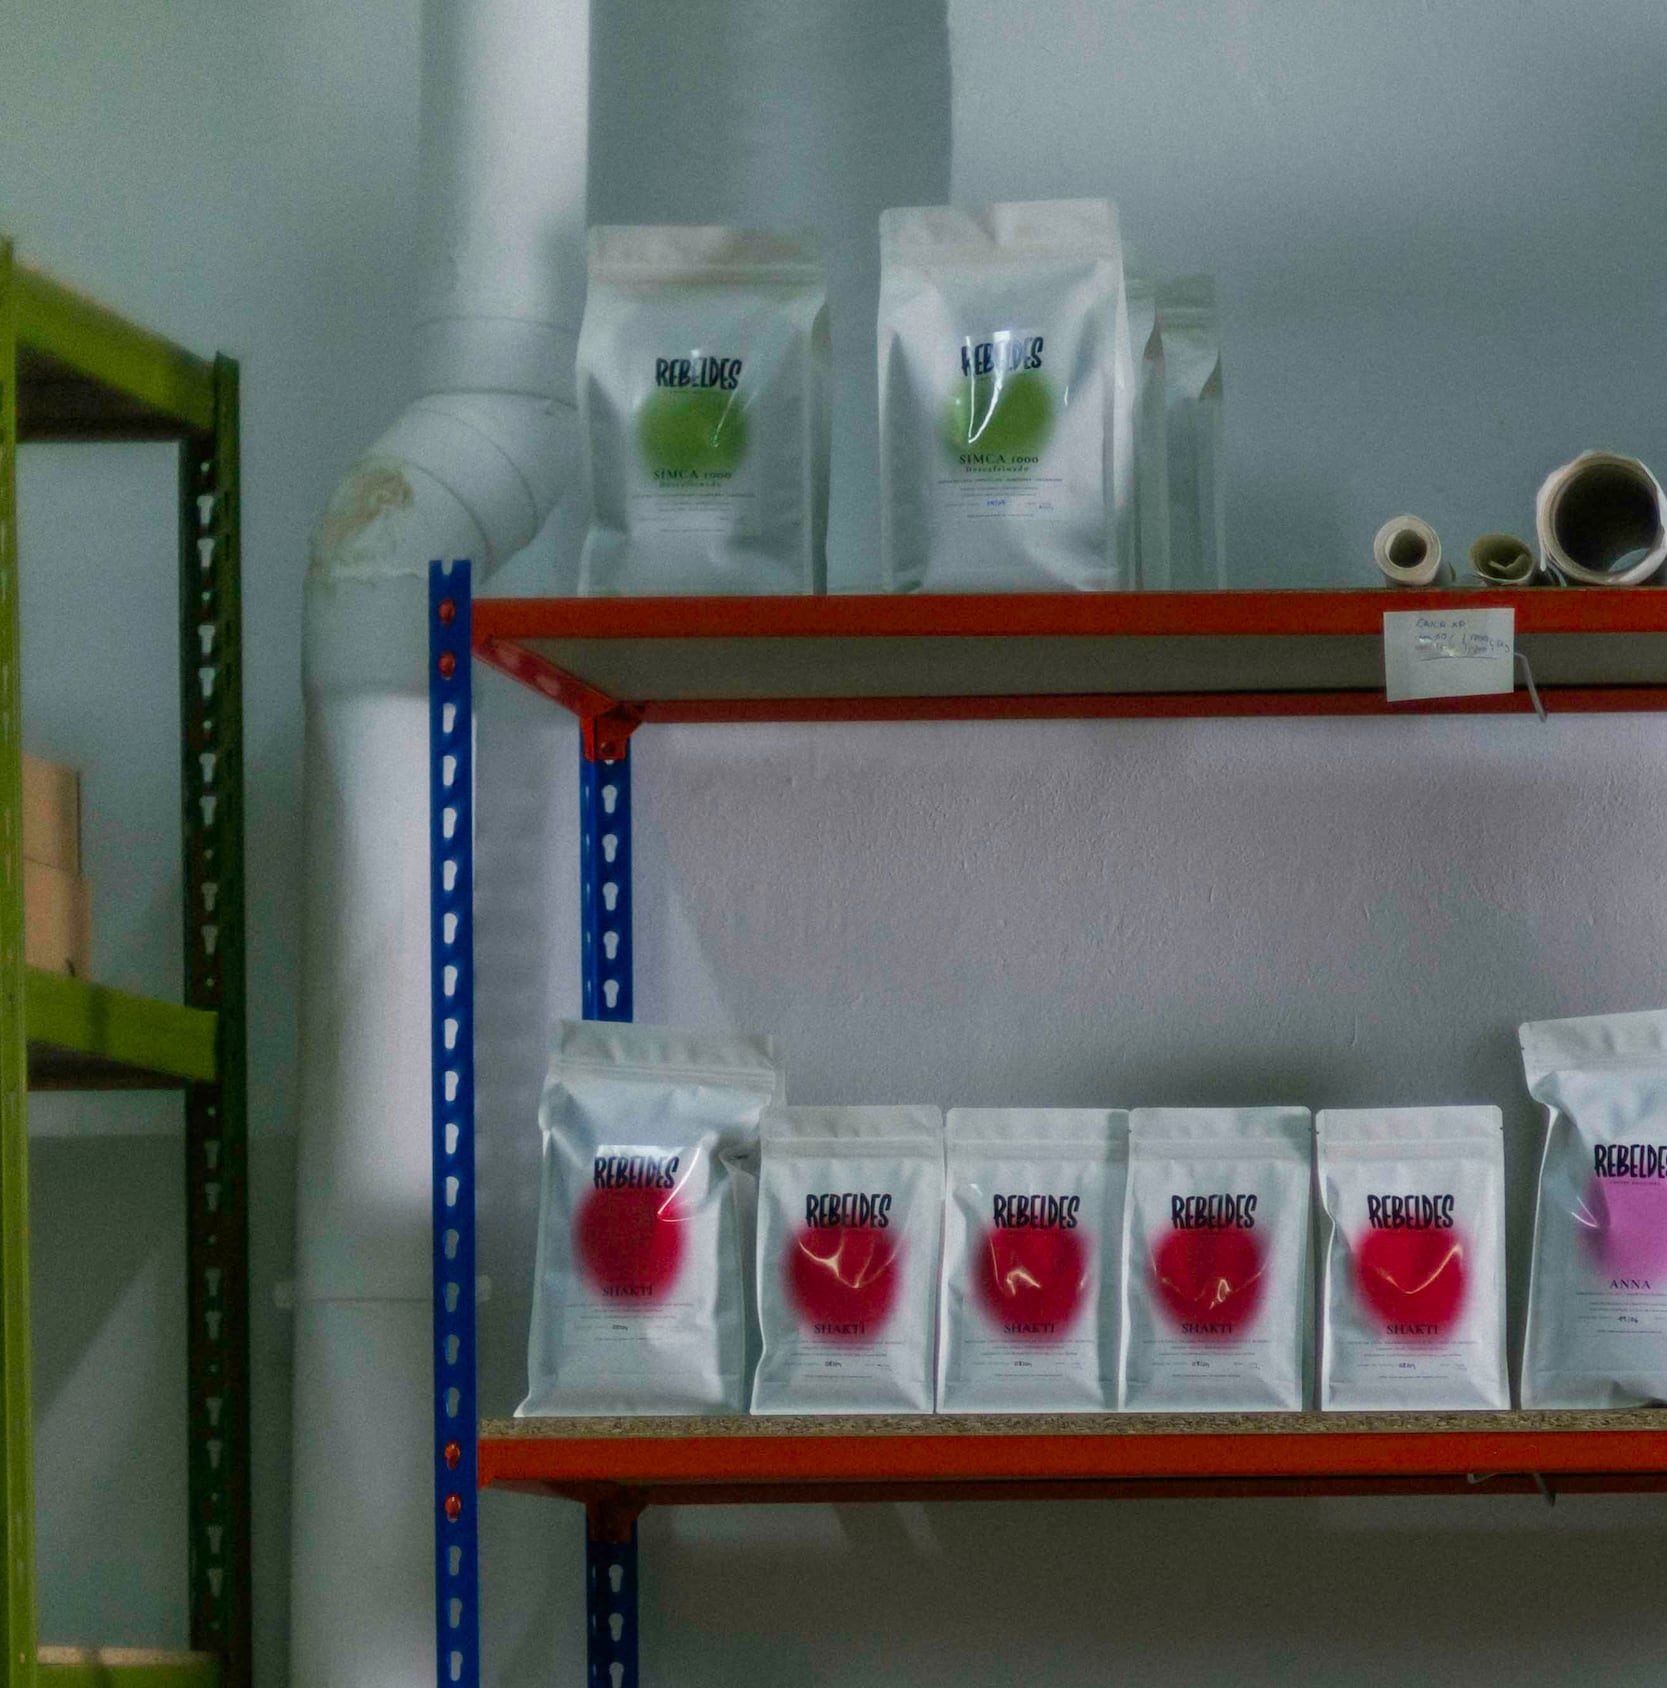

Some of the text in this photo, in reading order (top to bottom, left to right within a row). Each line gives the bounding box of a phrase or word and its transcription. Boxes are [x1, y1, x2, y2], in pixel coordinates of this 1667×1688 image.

[961, 336, 1044, 376] REBLDES
[656, 357, 742, 389] REBELDES
[959, 454, 1039, 464] SIMCA 1000
[594, 1155, 679, 1189] REBELDES
[806, 1193, 892, 1228] REBELDES
[994, 1194, 1081, 1229] REBELDES
[1171, 1193, 1257, 1229] REBELDES
[1367, 1193, 1454, 1230] REBELDES
[602, 1286, 653, 1297] SHAKTI
[1610, 1279, 1651, 1289] ANNA
[814, 1323, 866, 1334] SHAKTI
[1004, 1323, 1055, 1334] SHAKTI
[1181, 1323, 1233, 1334] SHAKTI
[1386, 1324, 1439, 1335] SHAKTI
